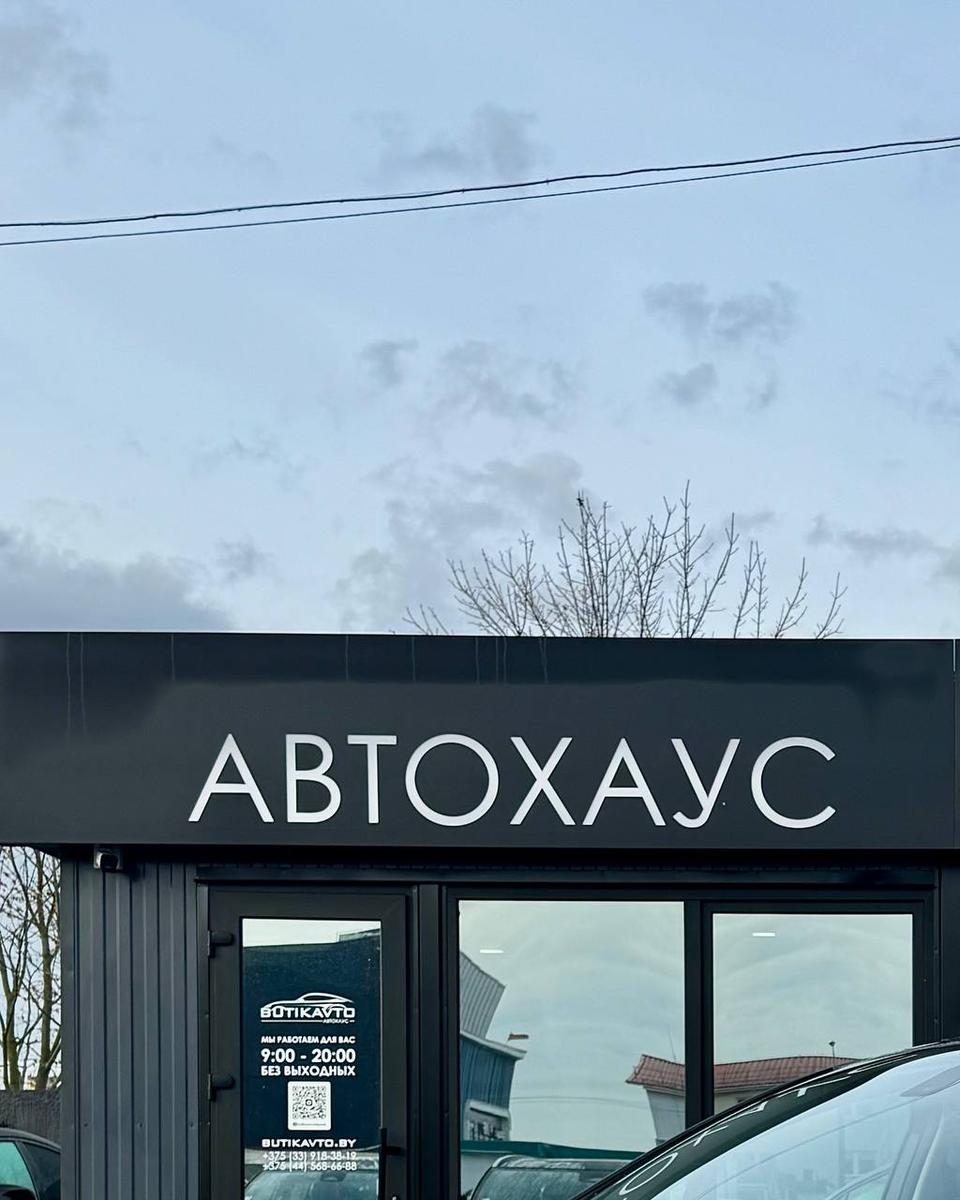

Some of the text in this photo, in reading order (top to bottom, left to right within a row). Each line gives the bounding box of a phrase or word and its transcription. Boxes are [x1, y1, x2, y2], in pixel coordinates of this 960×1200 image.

[188, 732, 837, 830] АВТОХАУС
[260, 1007, 356, 1019] BUTIKAVTO
[320, 1036, 337, 1044] ДЛЯ
[260, 1048, 296, 1063] 9:00
[311, 1048, 356, 1063] 20:00
[261, 1065, 356, 1077] БЕЗ ВЫХОДНЫХ
[261, 1139, 357, 1148] BUTIKAVTO.BY
[262, 1151, 287, 1161] +375
[289, 1151, 307, 1162] (33)
[289, 1161, 307, 1172] (44)
